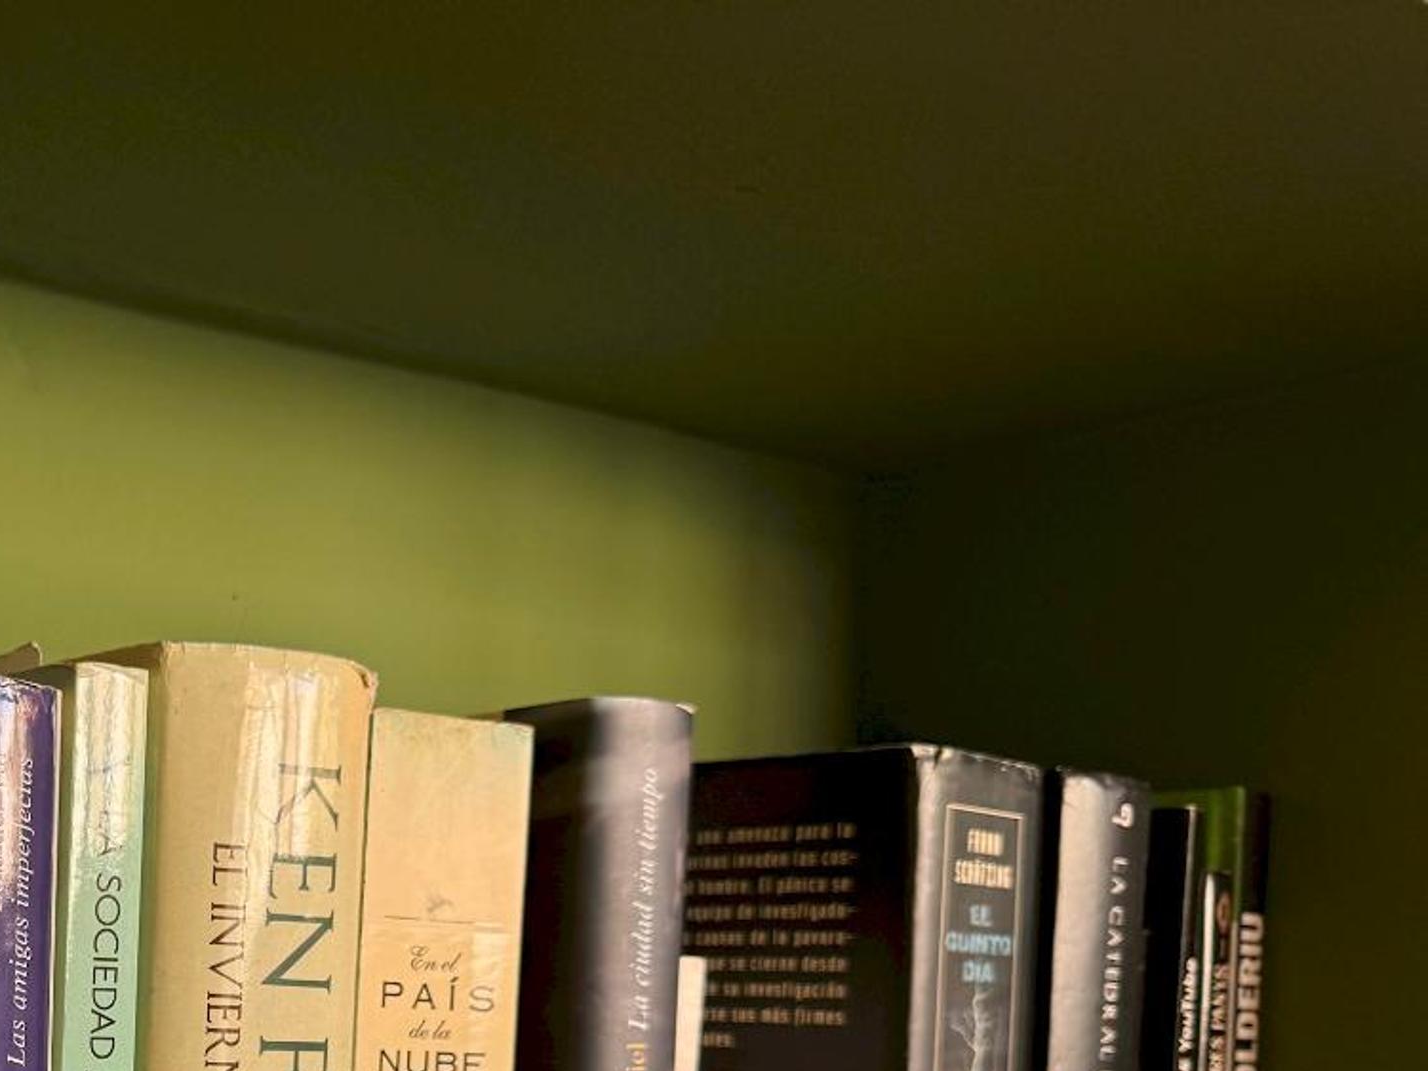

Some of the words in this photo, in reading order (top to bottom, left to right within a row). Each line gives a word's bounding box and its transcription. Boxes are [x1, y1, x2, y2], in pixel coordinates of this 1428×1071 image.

[16, 756, 36, 912] imperfectas
[641, 767, 664, 856] tiempo
[212, 841, 247, 887] EL
[261, 762, 342, 995] KEN
[639, 856, 657, 897] sin
[1110, 856, 1129, 895] LA
[9, 916, 33, 1013] amigas
[86, 872, 122, 1061] SOCIEDAD
[410, 946, 440, 972] En
[441, 952, 462, 973] el
[632, 898, 655, 988] ciudad
[380, 975, 496, 1013] PAÍS
[1099, 905, 1126, 1062] CATEDRAL
[409, 1019, 429, 1039] de
[430, 1020, 452, 1041] la
[628, 990, 650, 1033] La
[7, 1018, 28, 1068] Las
